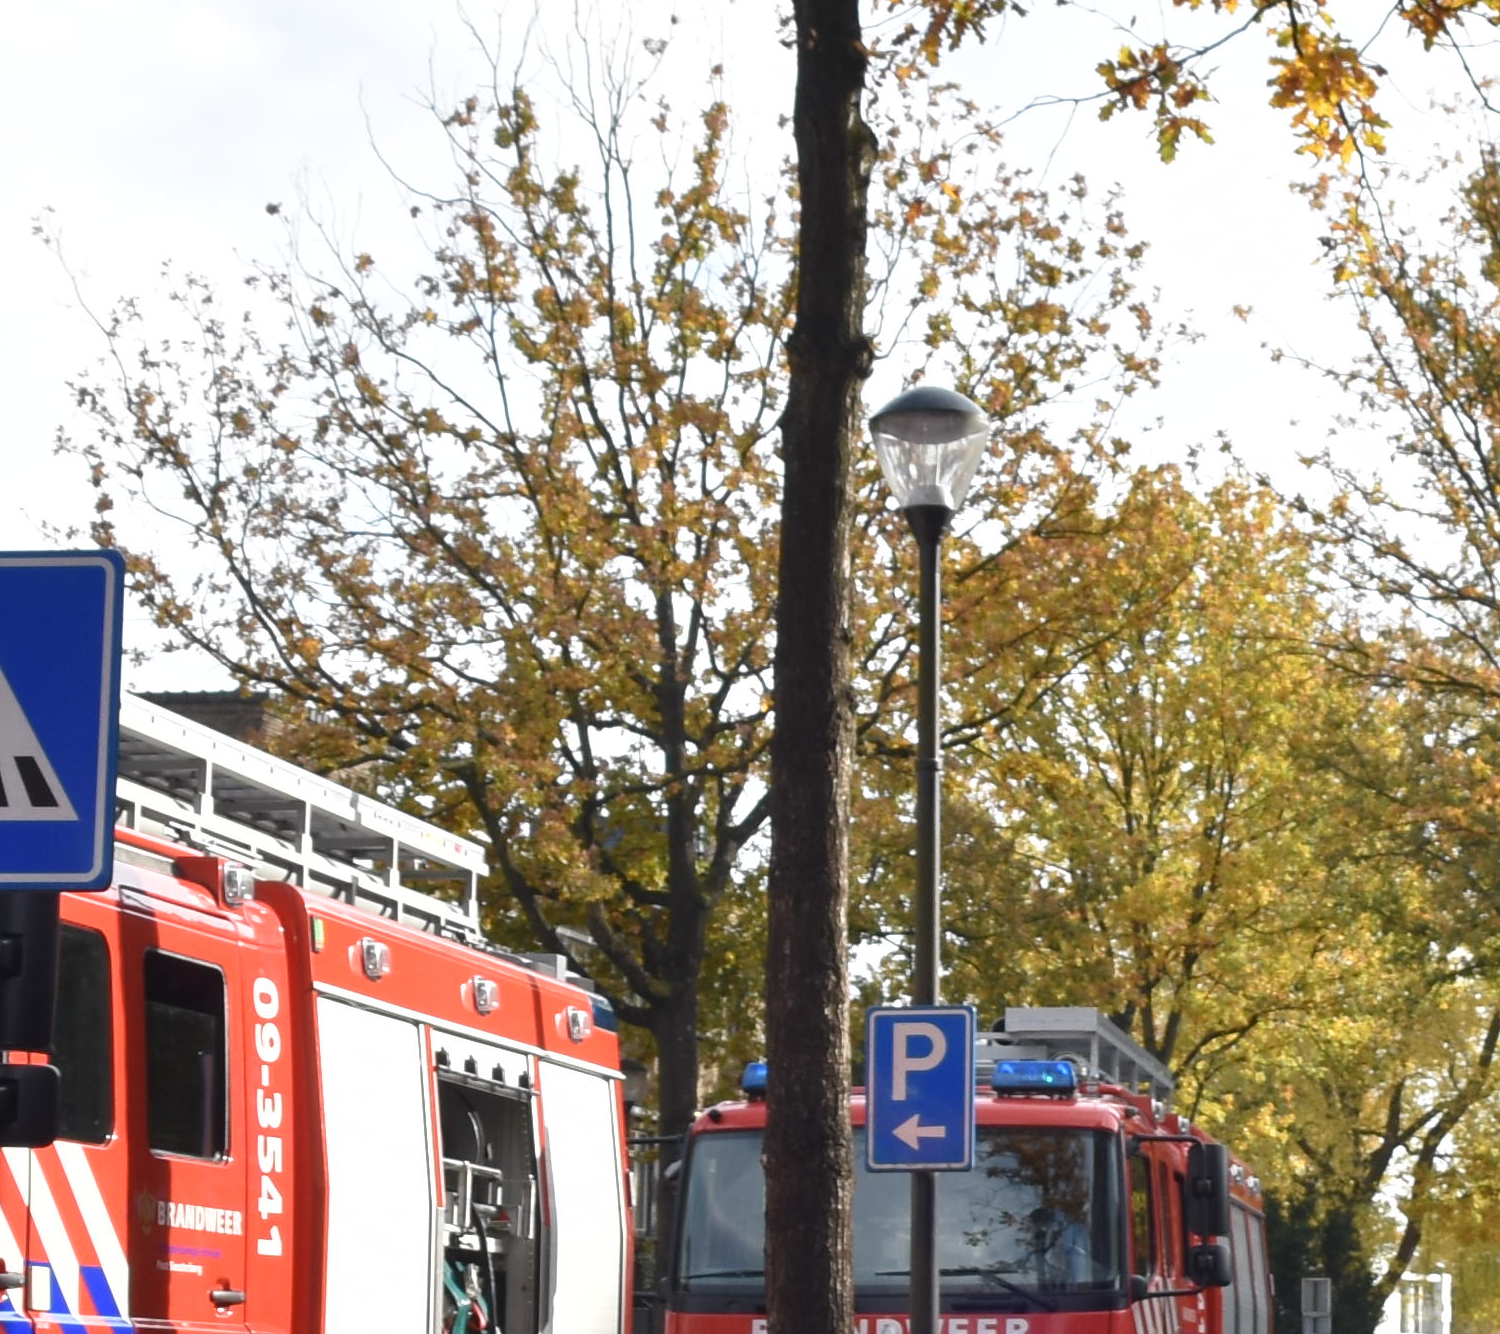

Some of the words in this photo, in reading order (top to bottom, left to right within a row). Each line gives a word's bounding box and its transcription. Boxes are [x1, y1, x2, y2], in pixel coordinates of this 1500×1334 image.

[891, 1022, 947, 1101] P
[252, 977, 283, 1257] 09-3541
[157, 1200, 243, 1236] BRANDWEER
